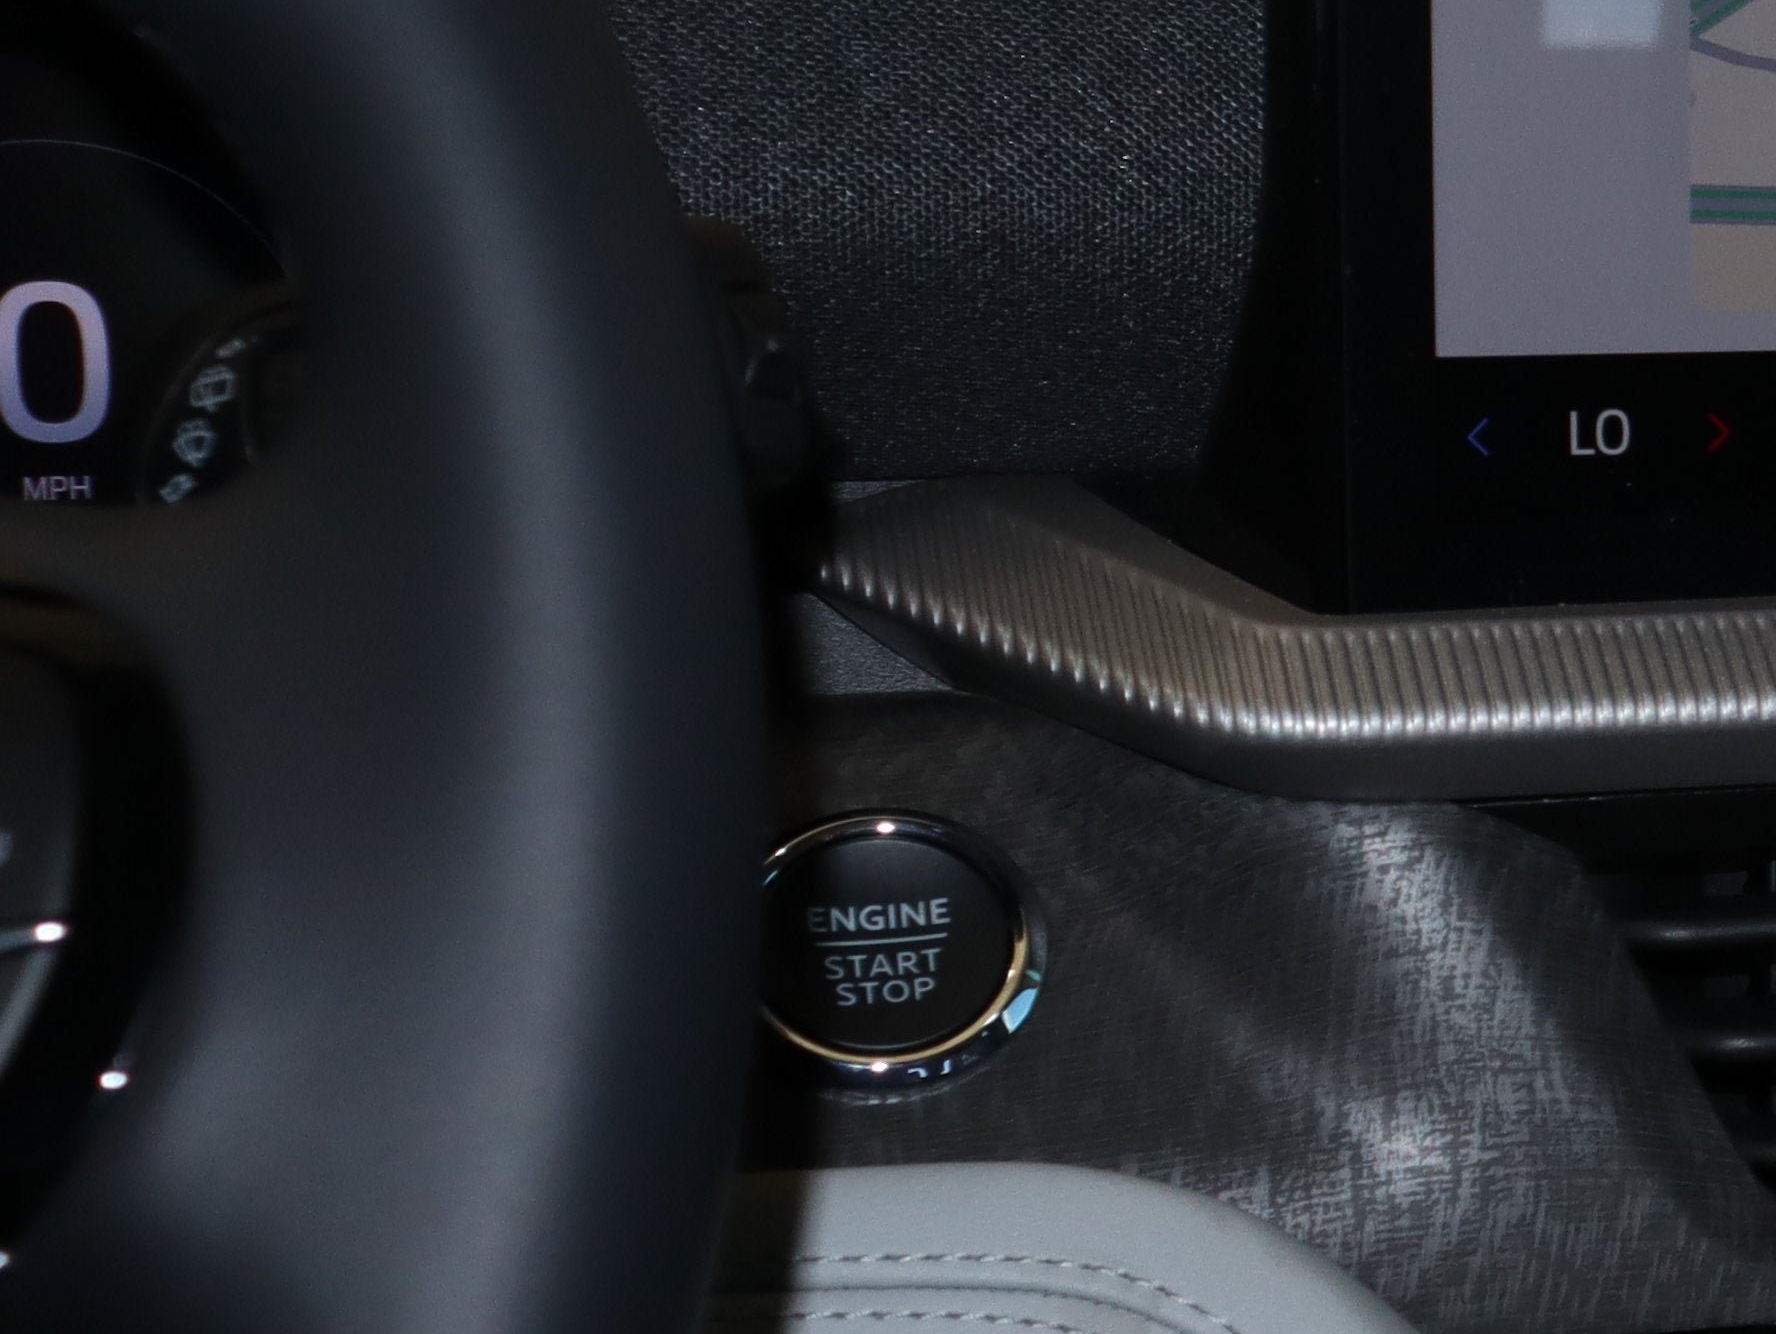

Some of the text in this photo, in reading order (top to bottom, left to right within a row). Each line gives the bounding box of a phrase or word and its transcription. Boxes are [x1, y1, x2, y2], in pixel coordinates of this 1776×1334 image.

[0, 279, 113, 446] 0
[1567, 407, 1632, 457] LO
[22, 473, 95, 503] MPH
[807, 896, 952, 933] ENGINE
[824, 948, 945, 981] START
[835, 976, 937, 1007] STOP
